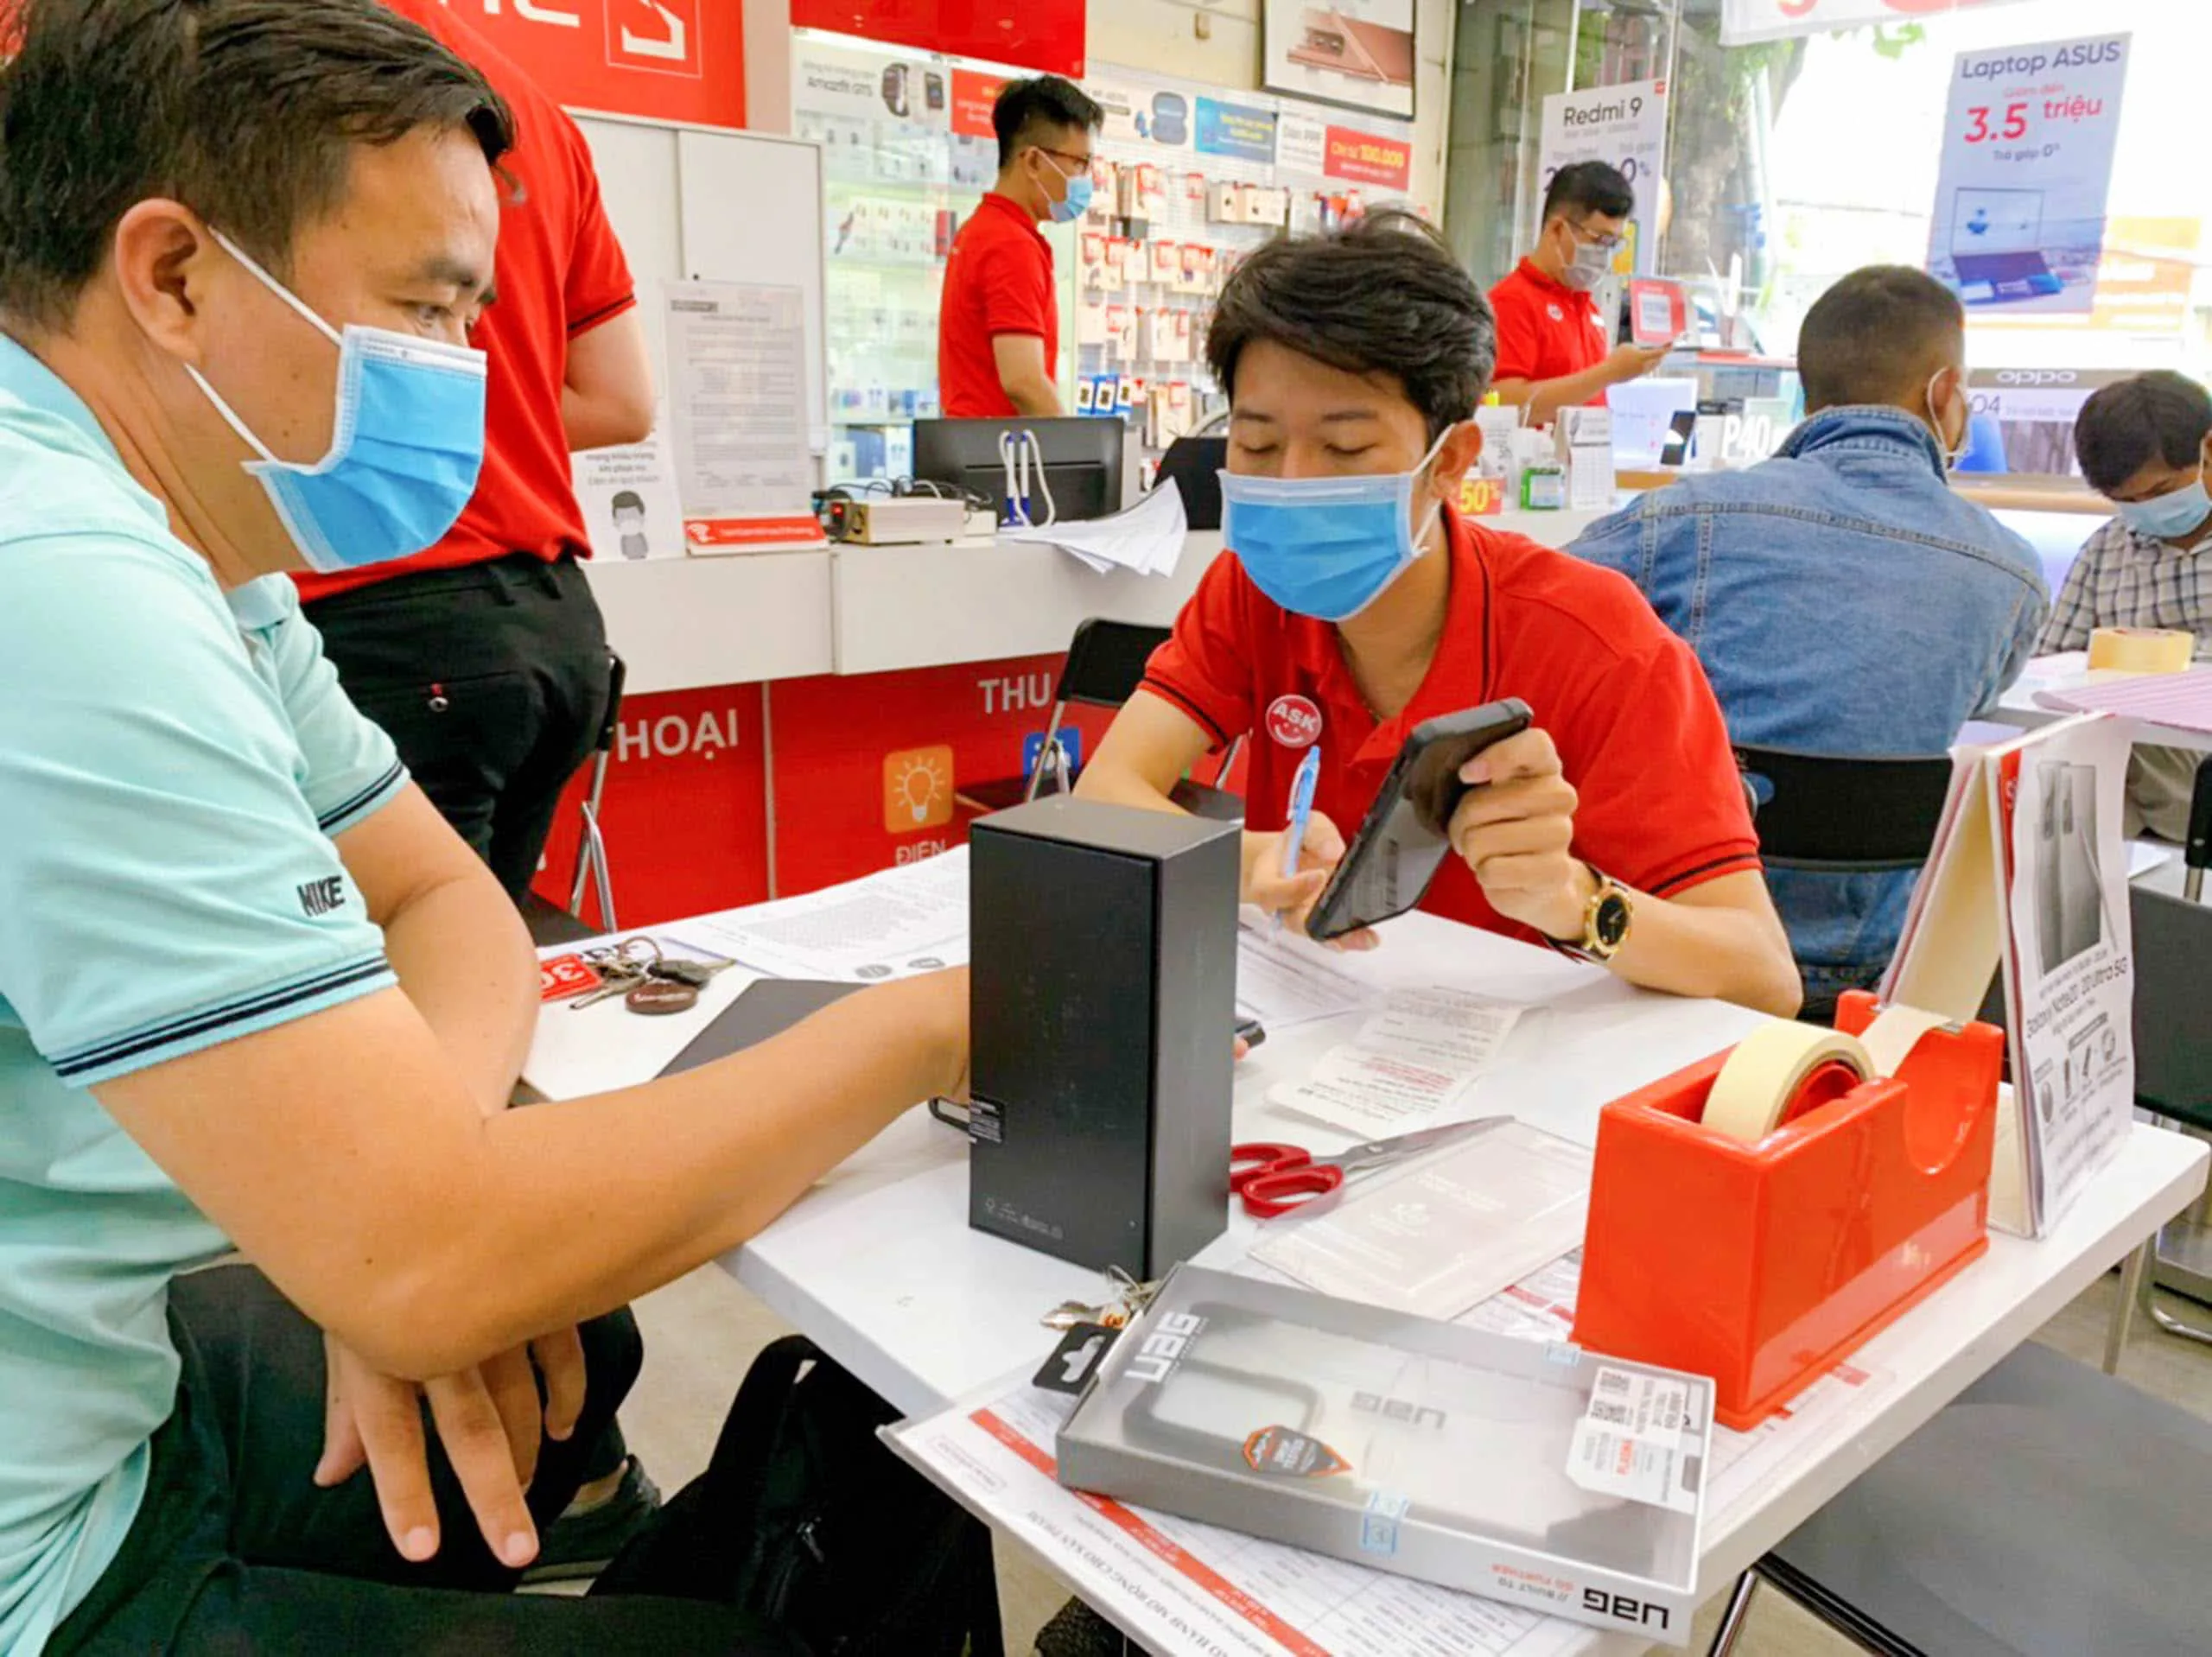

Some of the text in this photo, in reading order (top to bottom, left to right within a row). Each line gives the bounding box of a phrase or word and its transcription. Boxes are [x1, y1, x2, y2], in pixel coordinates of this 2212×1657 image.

[1962, 41, 2122, 81] Laptop ASUS
[1564, 97, 1643, 127] Redmi 9
[1964, 94, 2102, 143] 3.5 triệu
[977, 672, 1052, 714] THU
[1273, 702, 1317, 733] ASK
[296, 875, 345, 917] NIKE
[1582, 1586, 1669, 1630] UAG
